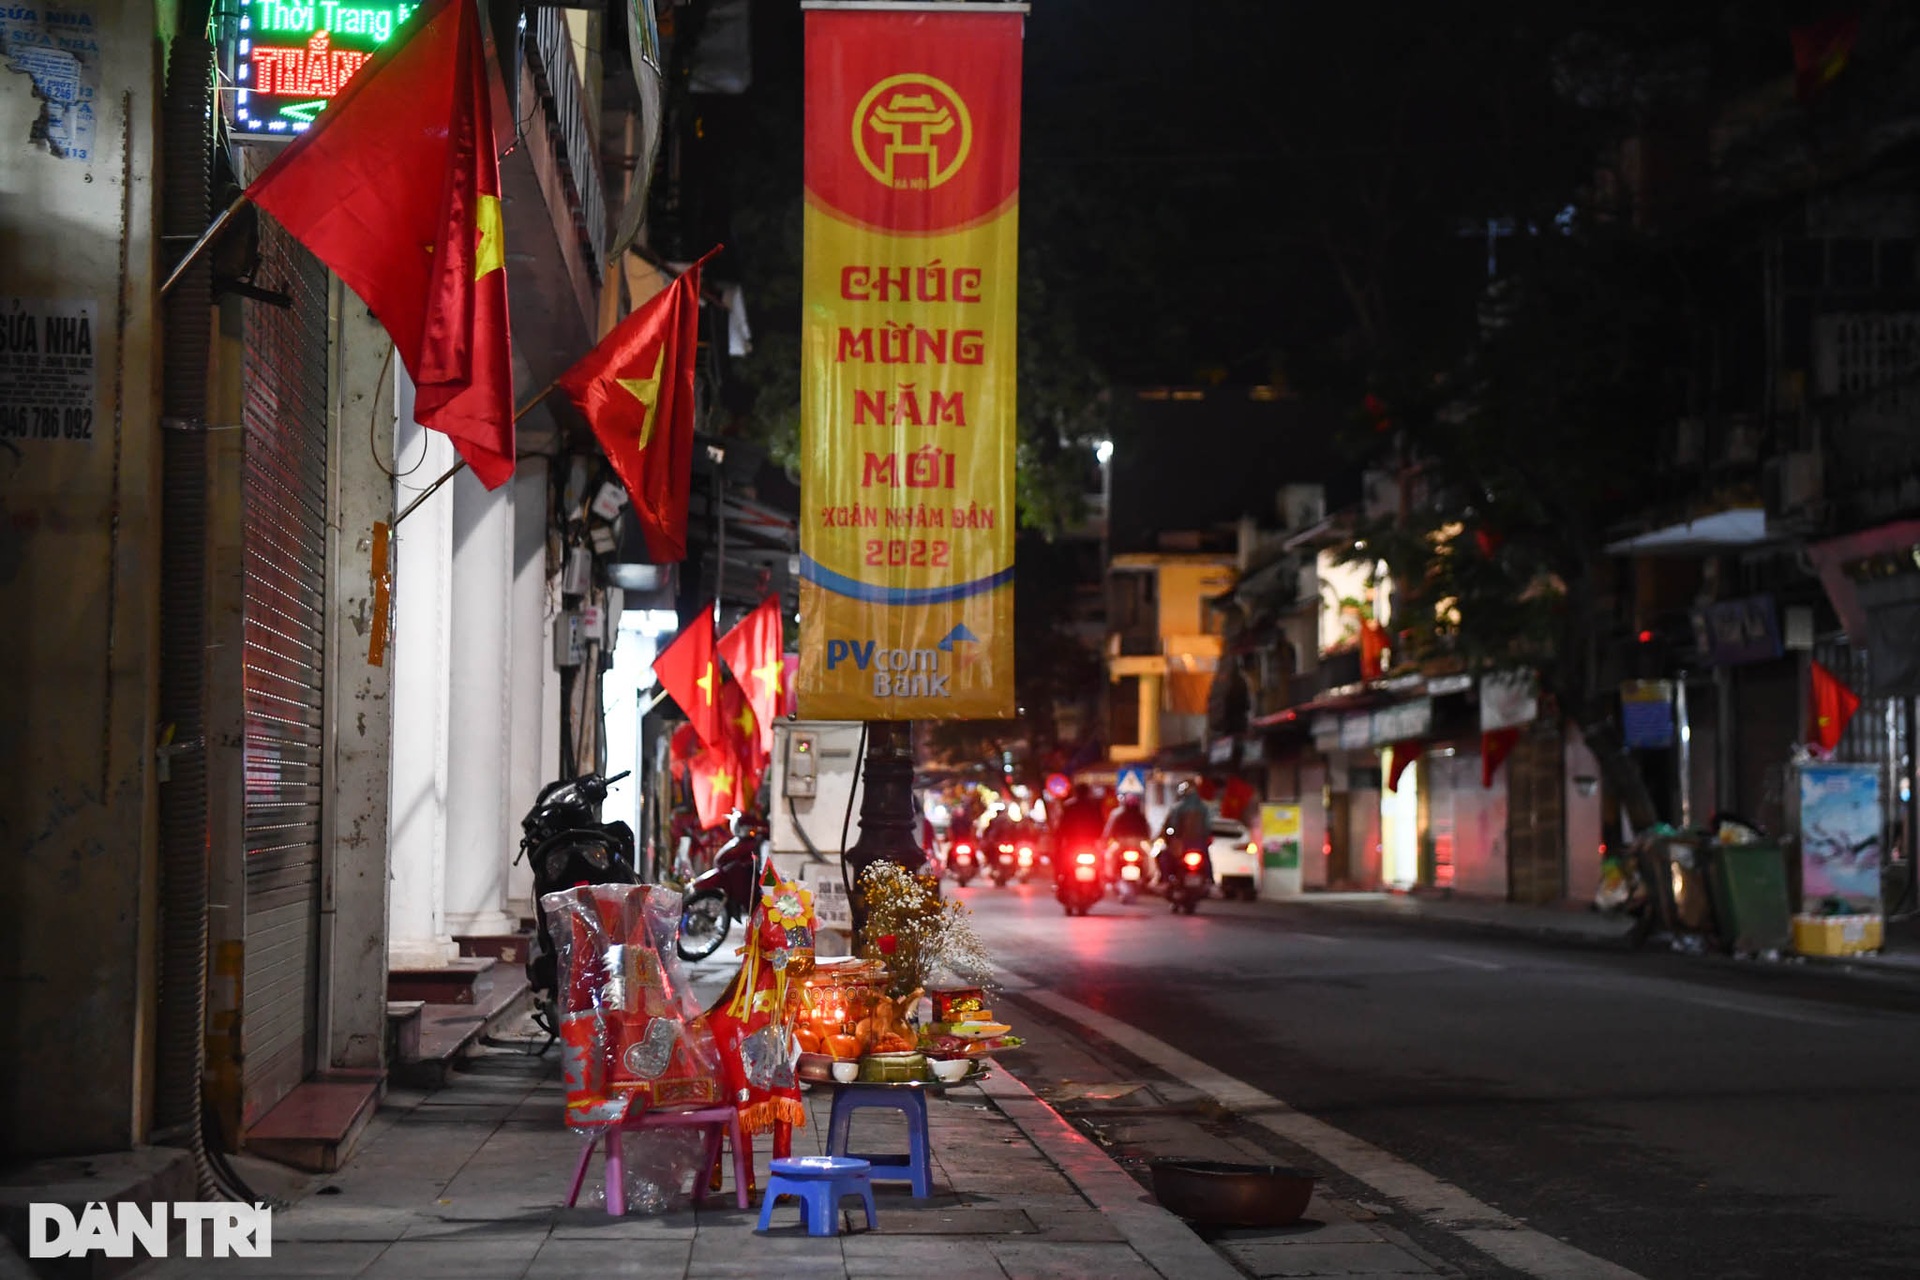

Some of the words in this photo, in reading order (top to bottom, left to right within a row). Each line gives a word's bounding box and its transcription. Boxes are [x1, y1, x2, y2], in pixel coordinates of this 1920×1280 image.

[256, 0, 315, 31] Thời
[320, 1, 392, 41] Trang
[252, 29, 374, 96] THẮN
[840, 259, 982, 303] CHÚC
[45, 309, 91, 355] NHÀ
[836, 321, 985, 365] MỪNG
[64, 407, 92, 439] 092
[853, 383, 966, 426] NĂM
[861, 444, 956, 489] MỚI
[822, 502, 878, 528] XUÂN
[885, 502, 944, 528] NHÂM
[865, 539, 950, 567] 2022
[827, 639, 938, 671] PVcom
[873, 672, 950, 697] Bank
